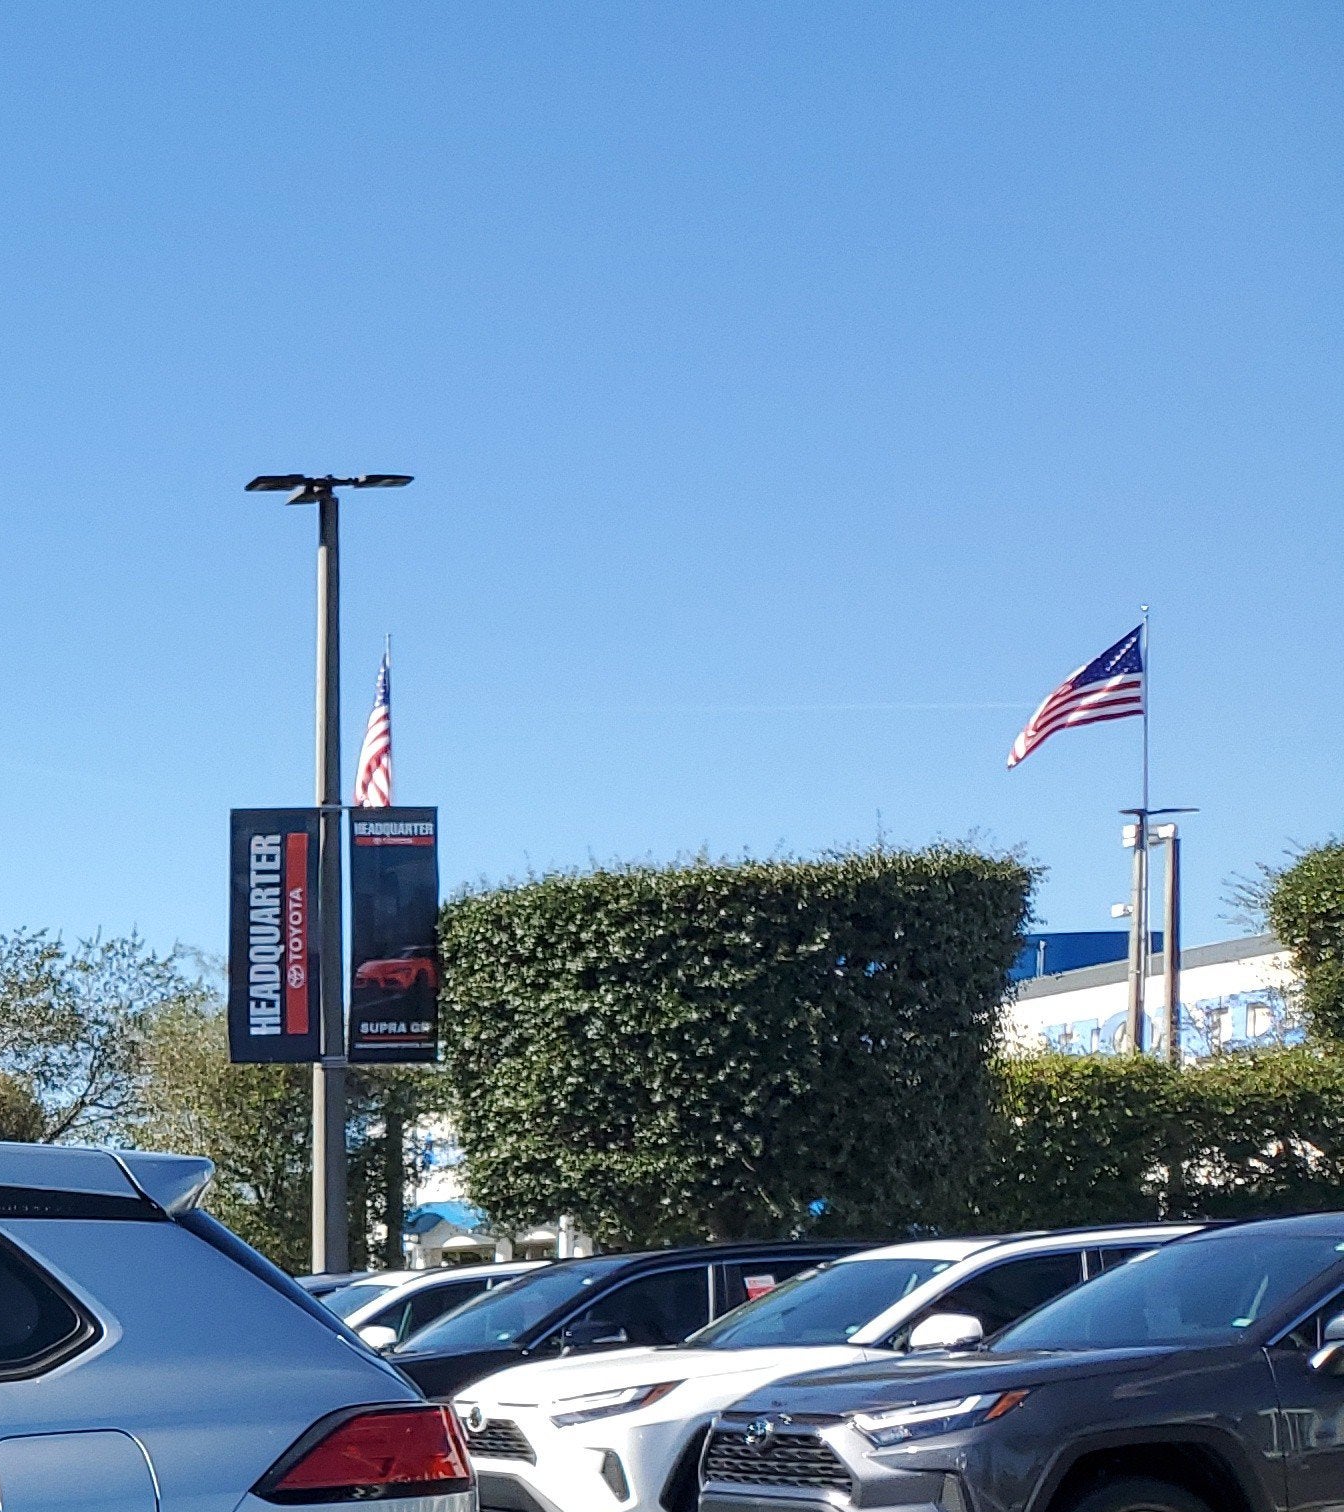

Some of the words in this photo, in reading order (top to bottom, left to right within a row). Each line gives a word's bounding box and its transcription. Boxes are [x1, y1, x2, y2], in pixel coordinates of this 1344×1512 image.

[249, 833, 285, 1036] HEADQUARTER
[288, 887, 304, 962] TOYOTA
[359, 1021, 407, 1034] SUPRA
